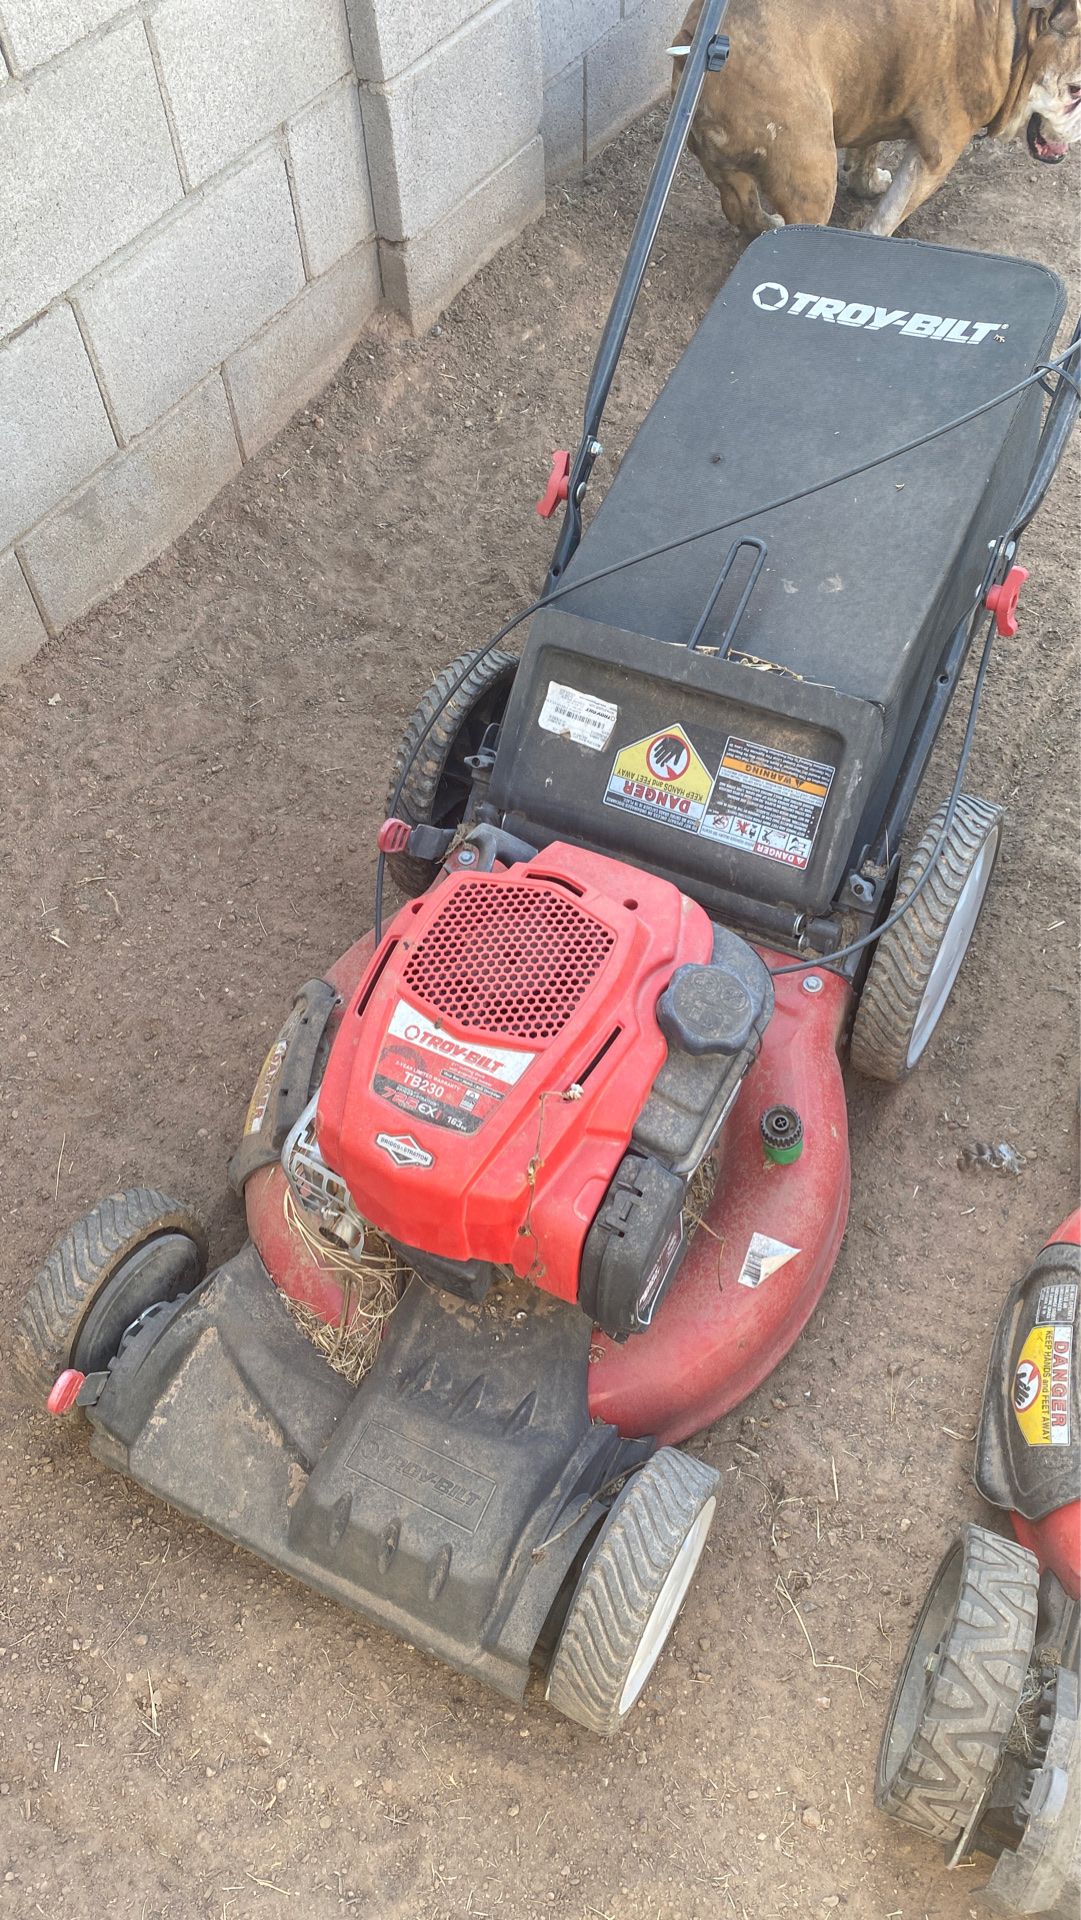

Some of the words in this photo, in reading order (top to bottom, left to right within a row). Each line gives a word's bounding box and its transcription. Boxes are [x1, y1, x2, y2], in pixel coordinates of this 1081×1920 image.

[787, 291, 1001, 345] TROY-BILT
[617, 768, 635, 779] AWAY
[635, 774, 651, 785] FEET
[651, 779, 664, 788] and
[745, 764, 792, 784] WARNING
[623, 780, 691, 814] DANGER
[663, 782, 686, 796] HANDS
[685, 791, 703, 801] KEEP
[756, 843, 795, 862] DANGER
[419, 1031, 504, 1073] TROY-BILT
[403, 1071, 445, 1098] TB230
[1045, 1330, 1053, 1350] KEEP
[1042, 1350, 1052, 1378] HANDS
[1051, 1340, 1070, 1428] DANGER
[1041, 1394, 1049, 1416] FEET
[1041, 1416, 1049, 1440] AWAY
